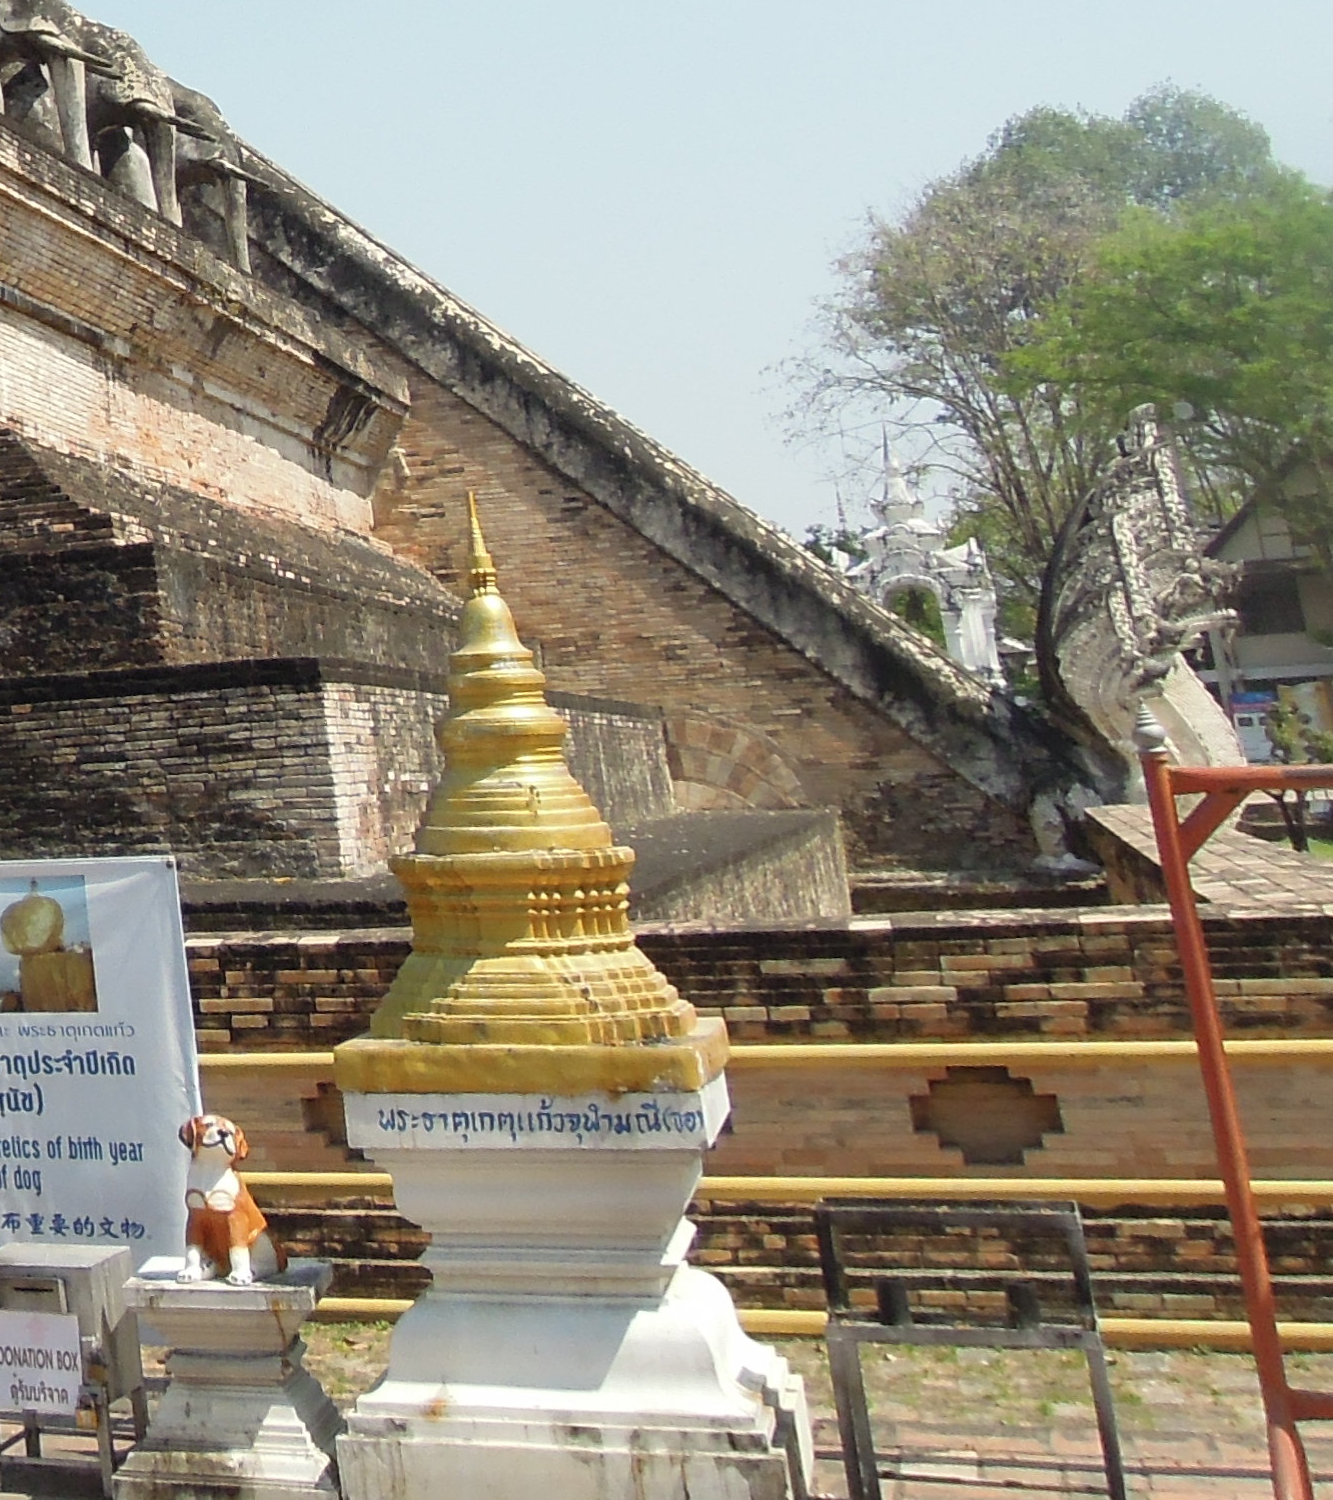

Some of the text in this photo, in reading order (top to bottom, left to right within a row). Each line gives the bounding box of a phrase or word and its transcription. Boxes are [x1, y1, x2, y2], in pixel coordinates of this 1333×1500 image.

[46, 1136, 63, 1159] of
[68, 1136, 103, 1161] birth
[109, 1140, 145, 1166] year
[14, 1164, 43, 1197] dog
[56, 1349, 80, 1373] BOX
